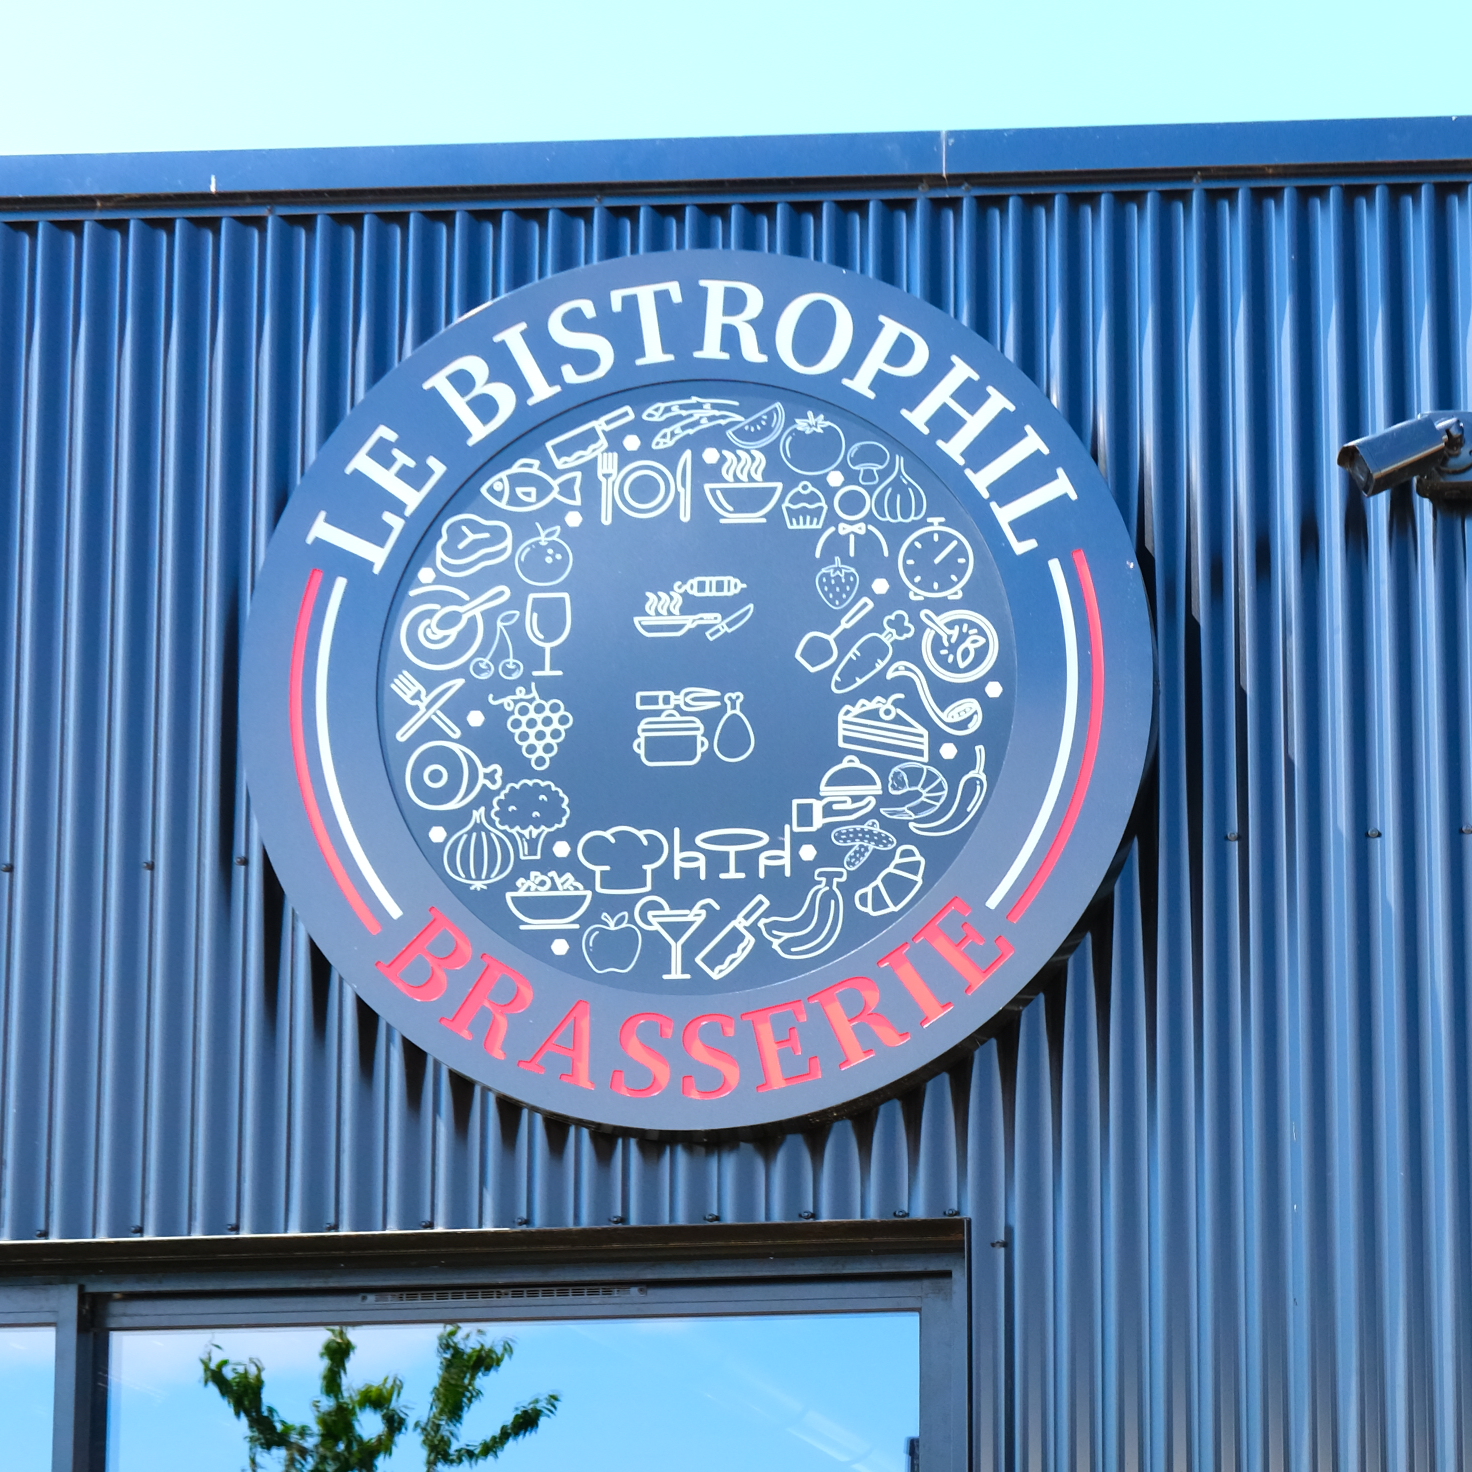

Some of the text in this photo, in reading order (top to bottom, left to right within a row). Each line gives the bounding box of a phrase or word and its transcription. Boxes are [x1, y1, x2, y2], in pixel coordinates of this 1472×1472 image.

[307, 279, 1080, 578] LE BISTROPHIL
[375, 895, 1016, 1102] BRASSERIE
